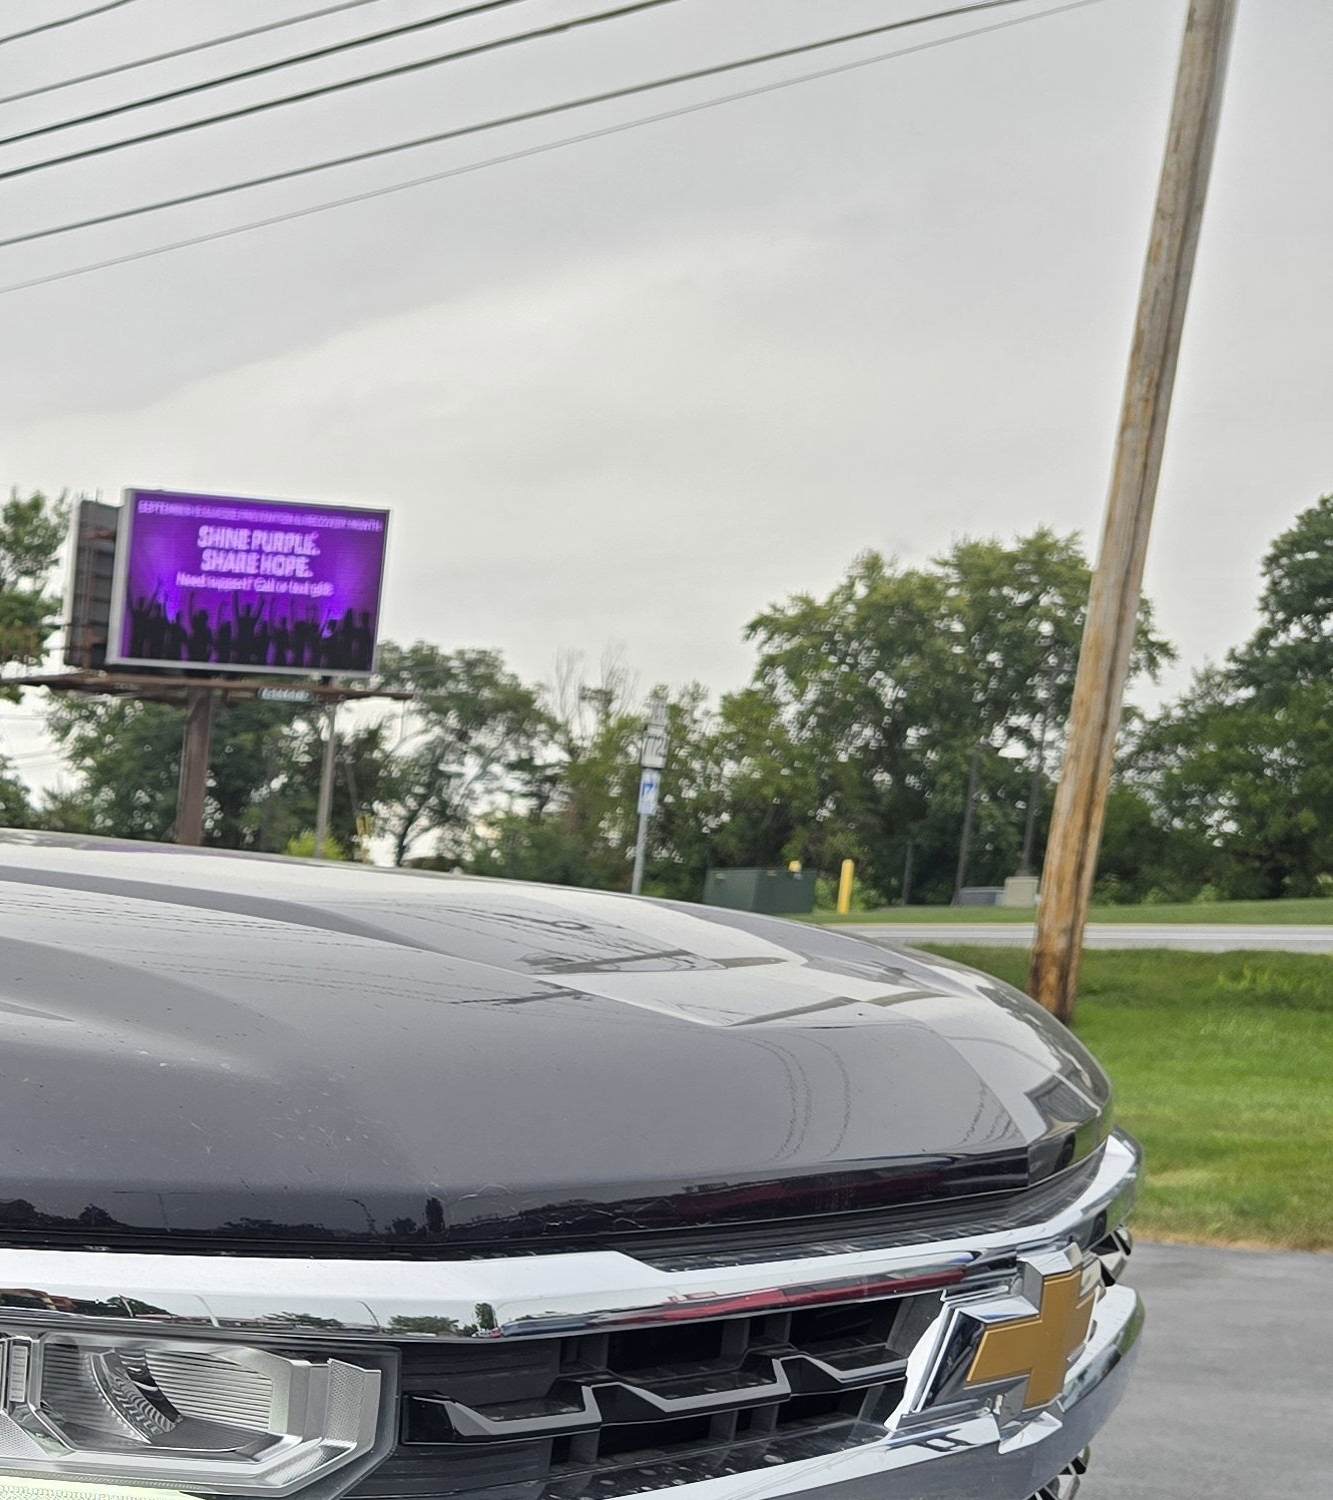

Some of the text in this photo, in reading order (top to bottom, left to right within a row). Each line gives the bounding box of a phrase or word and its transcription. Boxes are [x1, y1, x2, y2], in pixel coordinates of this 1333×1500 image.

[197, 525, 251, 550] SHINE
[200, 549, 314, 578] SHARE HOPE.
